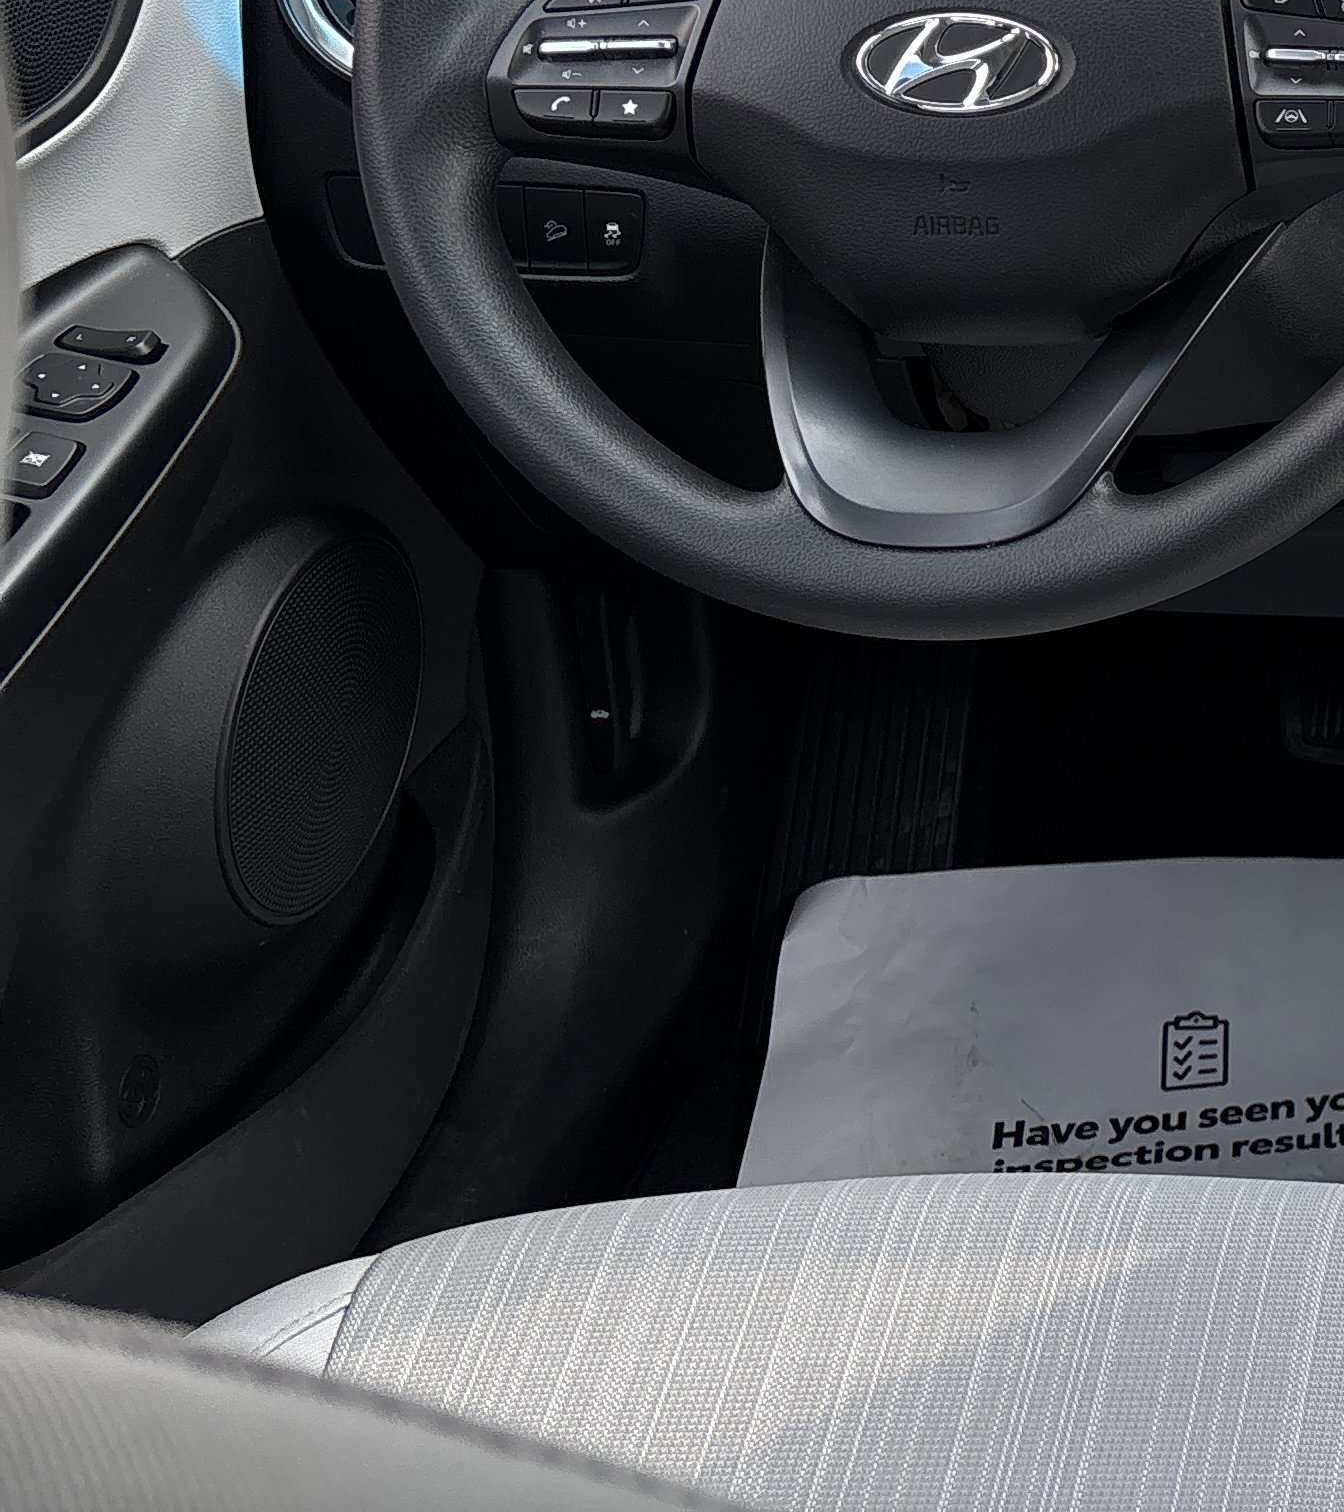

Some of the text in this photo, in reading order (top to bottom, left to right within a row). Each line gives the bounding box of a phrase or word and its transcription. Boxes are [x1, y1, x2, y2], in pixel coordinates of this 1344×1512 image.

[913, 215, 1000, 236] AIRBAG
[605, 238, 621, 246] OFF
[992, 1118, 1099, 1151] Have
[1107, 1110, 1188, 1145] you
[1197, 1096, 1296, 1130] seen
